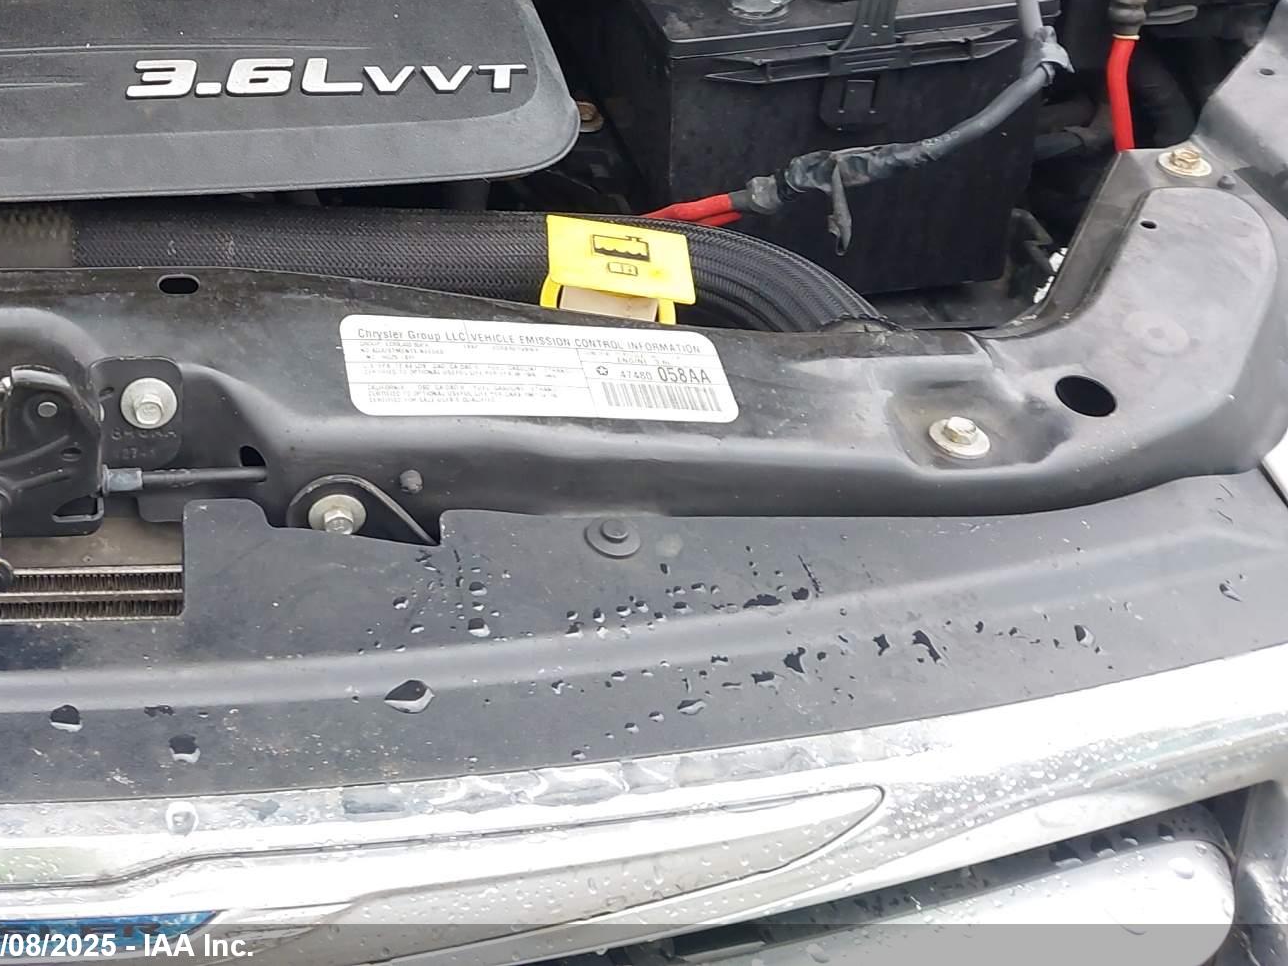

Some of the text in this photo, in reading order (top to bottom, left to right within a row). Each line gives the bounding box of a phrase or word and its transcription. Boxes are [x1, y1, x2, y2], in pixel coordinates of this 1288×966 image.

[358, 328, 701, 354] Chrysler Group LLC VEHICLE EMISSION CONTROL INFORMATION
[657, 366, 712, 383] 058AA
